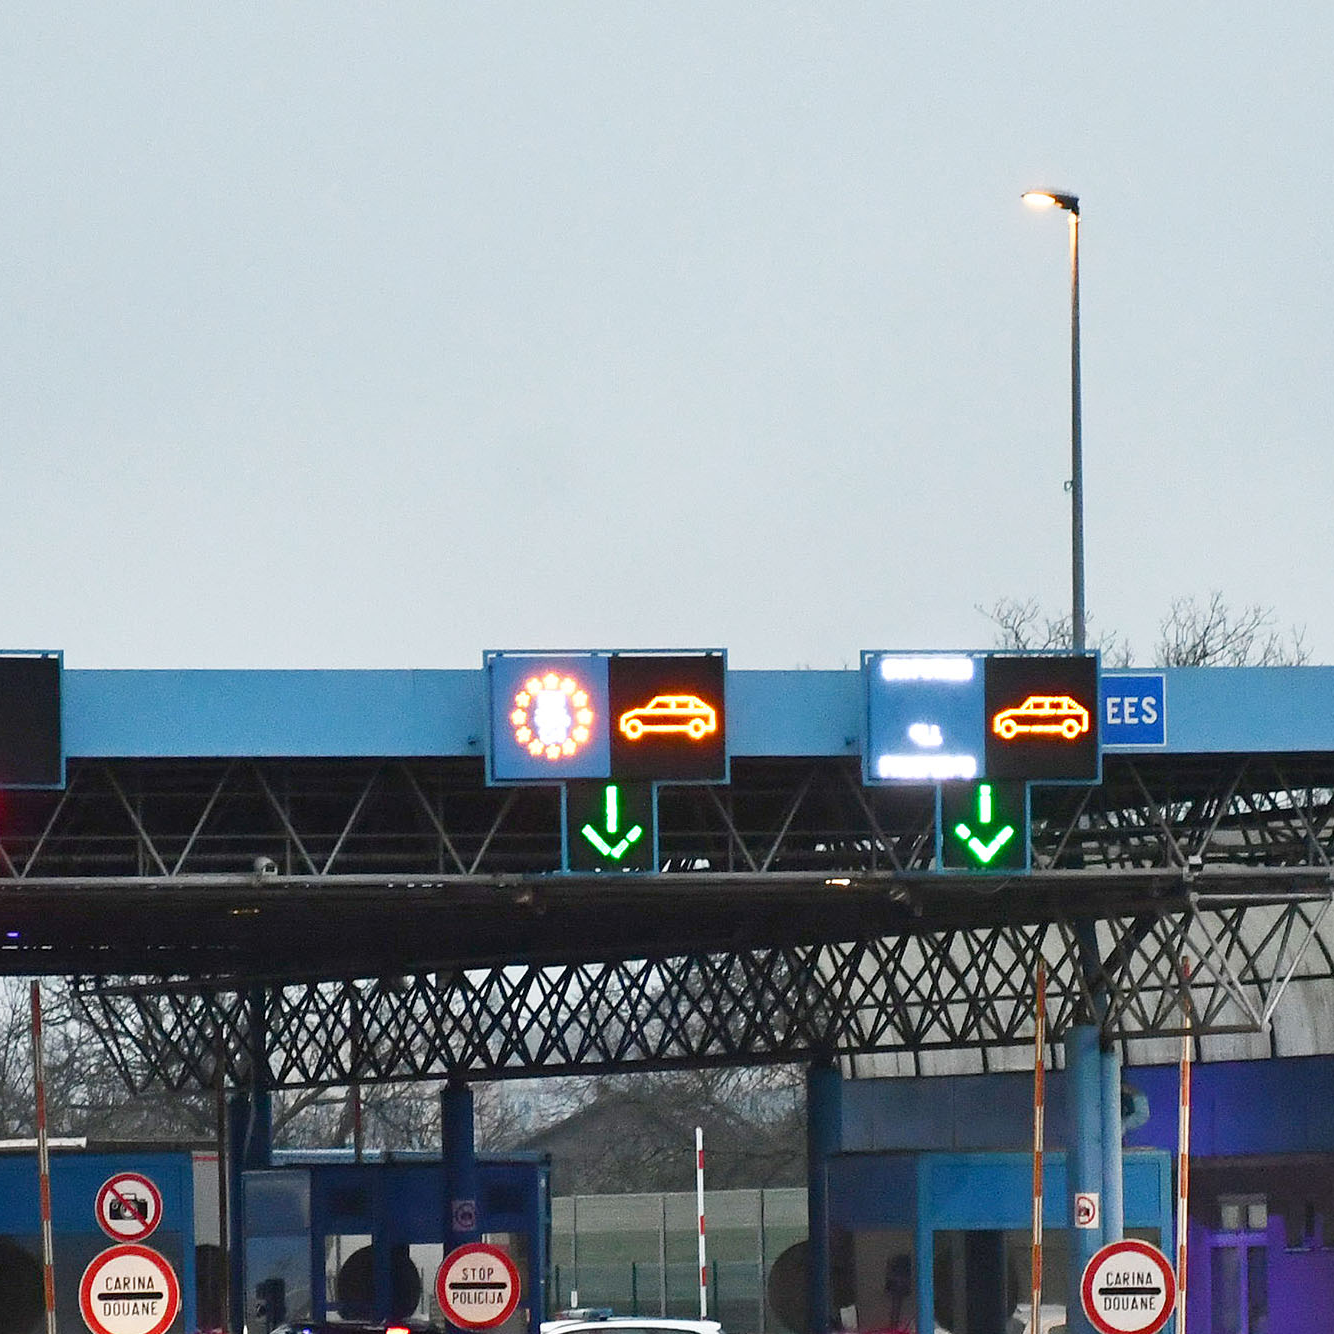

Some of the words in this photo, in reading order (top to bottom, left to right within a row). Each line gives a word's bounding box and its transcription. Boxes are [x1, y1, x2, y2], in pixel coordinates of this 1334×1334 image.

[1107, 696, 1158, 724] EES
[462, 1267, 494, 1281] STOP
[1106, 1271, 1153, 1286] CARINA
[105, 1276, 155, 1291] CARINA
[452, 1291, 504, 1305] POLICIJA
[1104, 1297, 1156, 1311] DOUANE
[103, 1301, 158, 1316] DOUANE
